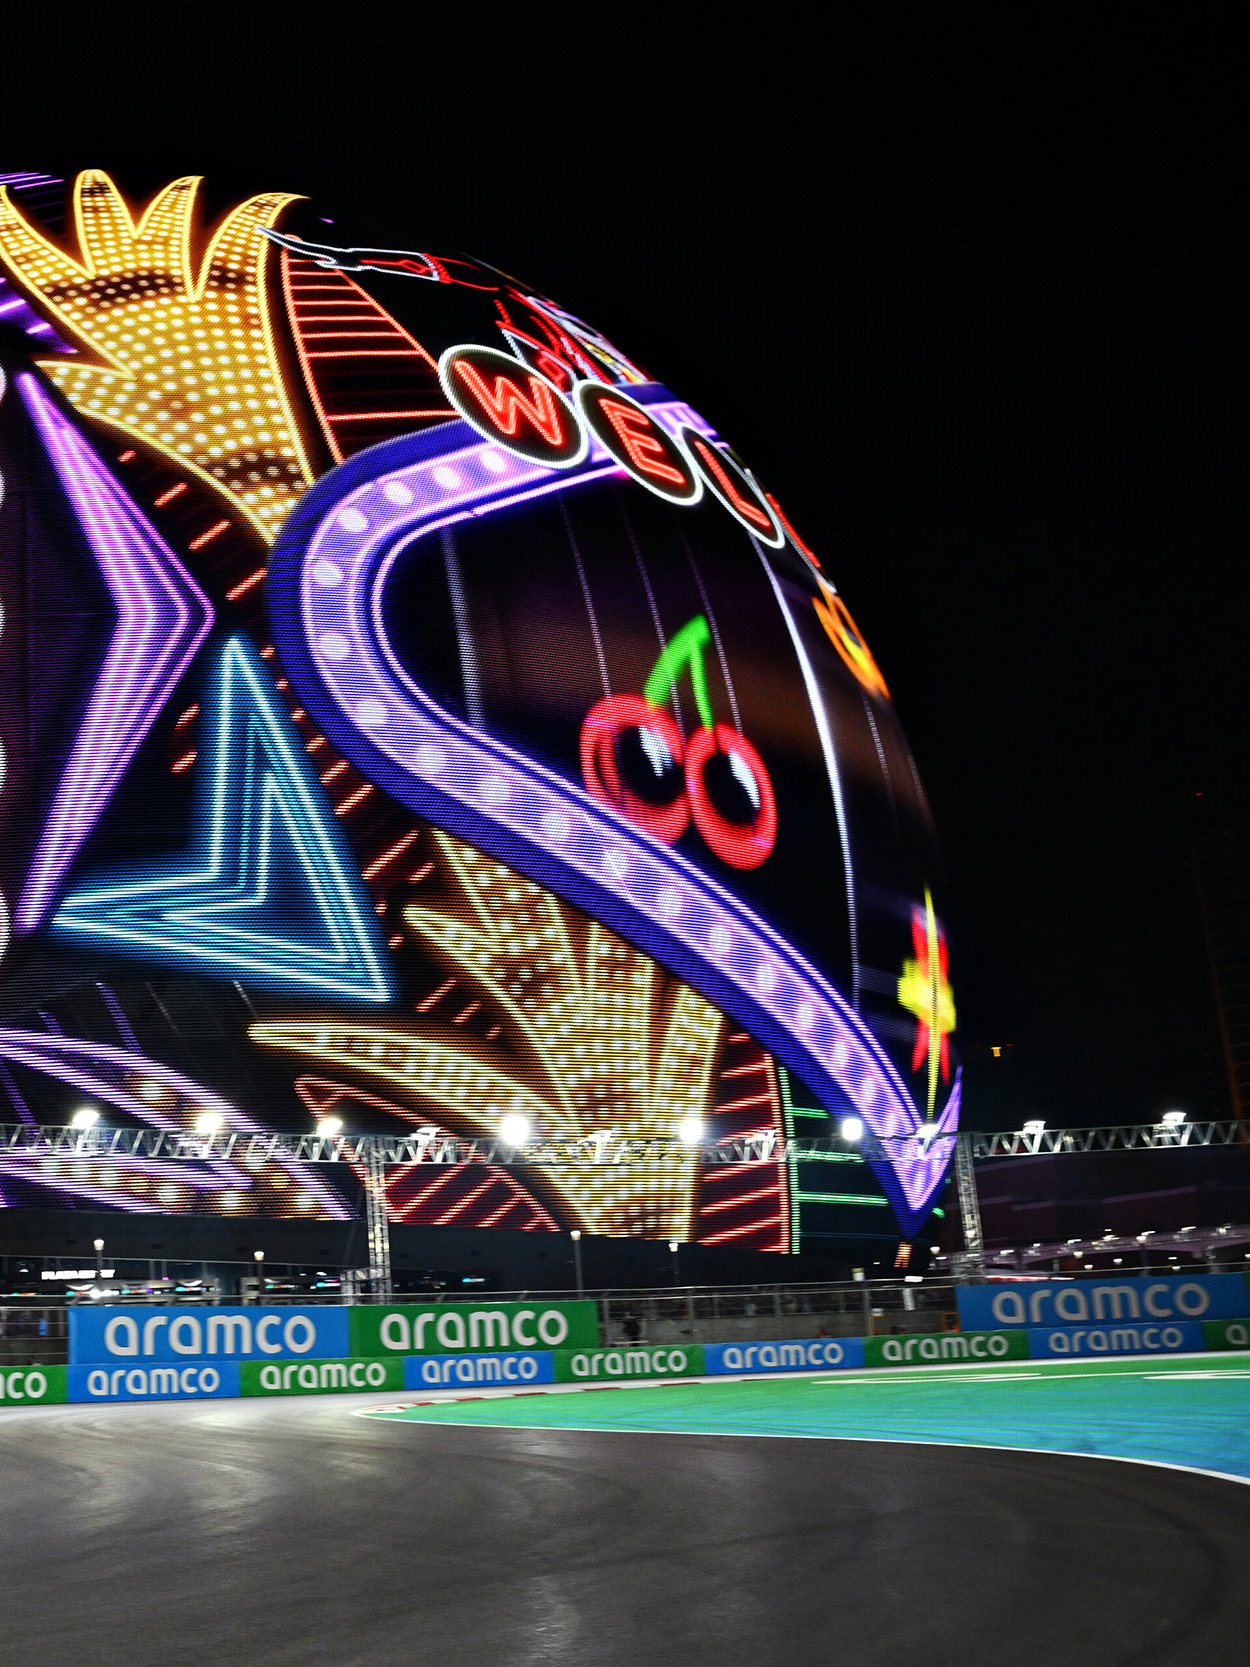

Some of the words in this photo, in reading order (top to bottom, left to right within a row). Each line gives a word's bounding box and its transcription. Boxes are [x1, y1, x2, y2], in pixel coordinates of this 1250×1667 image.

[453, 359, 822, 569] WEL
[992, 1282, 1210, 1325] aramco
[105, 1315, 316, 1356] aramco
[380, 1309, 568, 1351] aramco
[1049, 1327, 1184, 1353] aramco
[723, 1342, 844, 1369] aramco
[882, 1335, 1008, 1362] aramco
[259, 1362, 386, 1390] aramco
[422, 1356, 537, 1383] aramco
[571, 1349, 687, 1377] aramco
[87, 1367, 220, 1396] aramco
